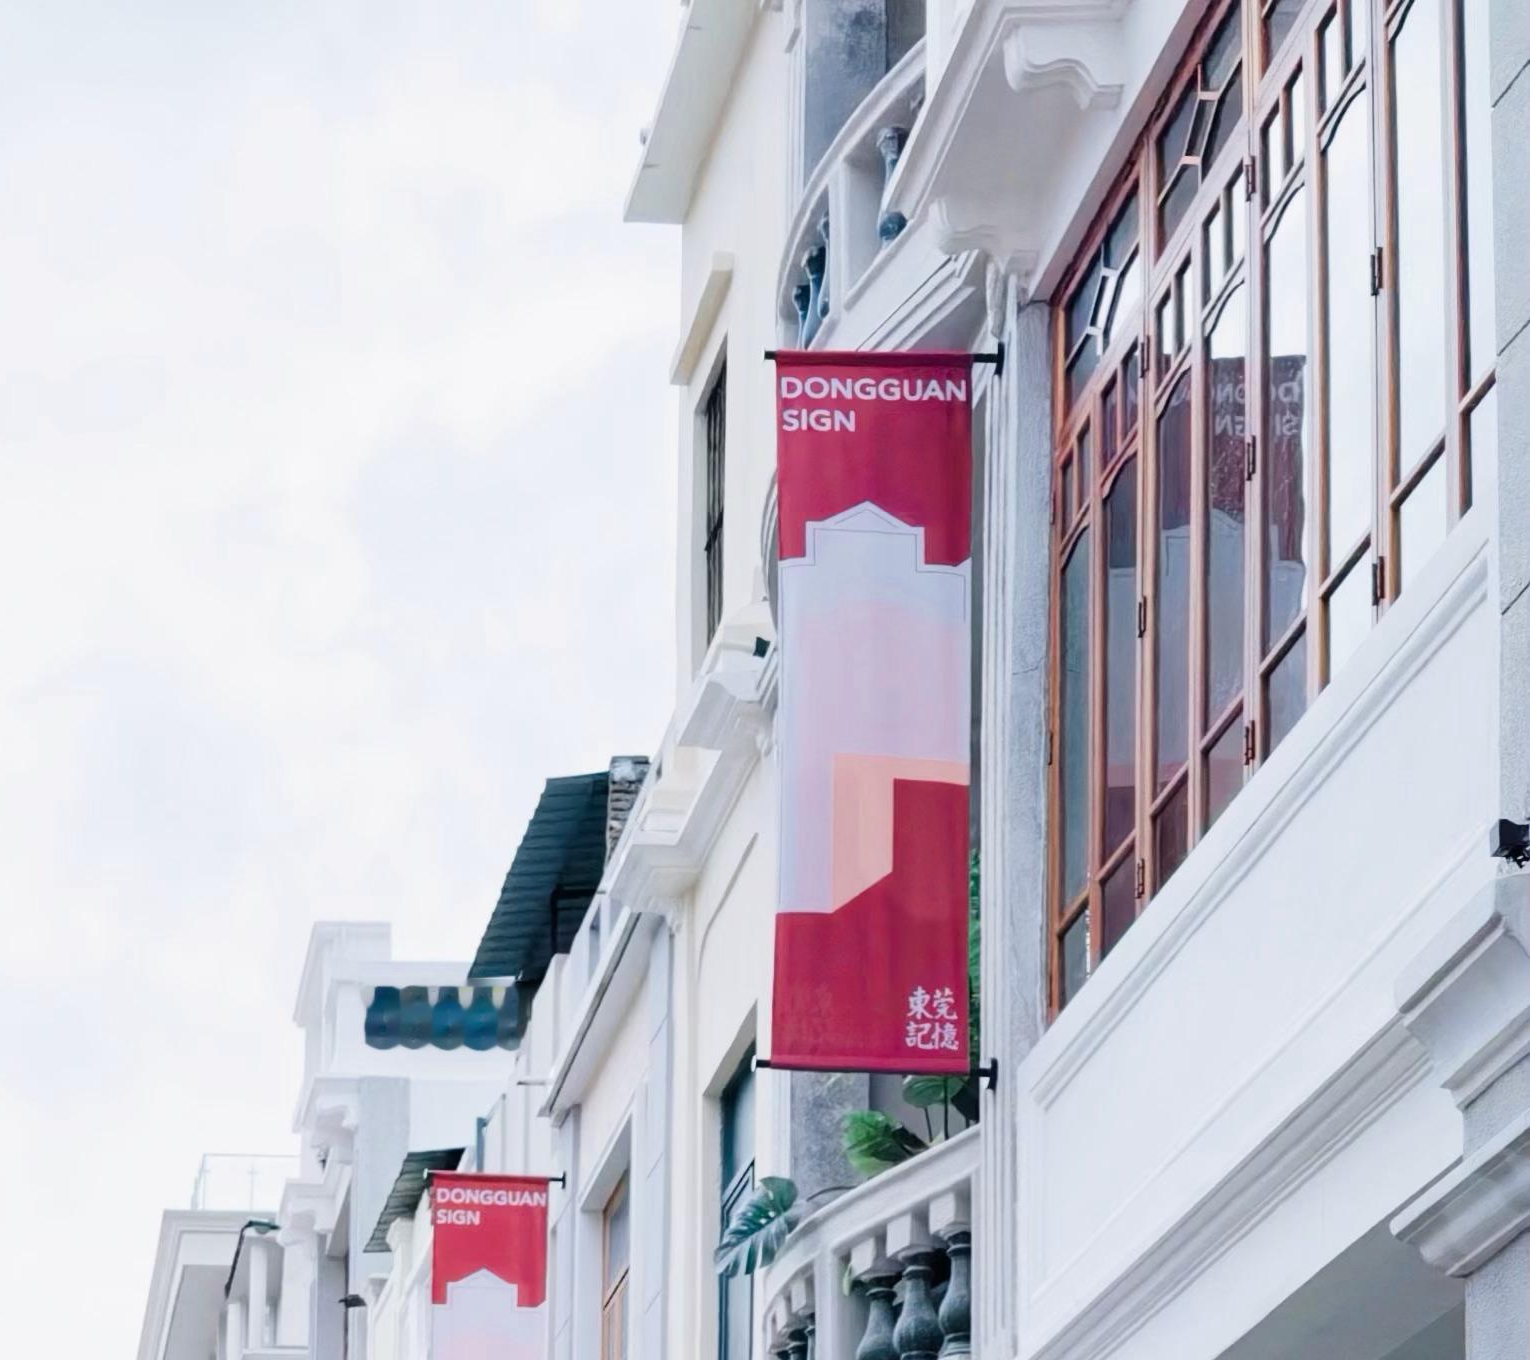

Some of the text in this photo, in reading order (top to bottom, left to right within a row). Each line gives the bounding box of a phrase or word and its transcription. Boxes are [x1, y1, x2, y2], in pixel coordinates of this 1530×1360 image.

[781, 376, 967, 402] DONGGUAN
[782, 408, 856, 432] SIGN
[907, 986, 958, 1019] 東莞
[905, 1021, 959, 1050] 記憶
[436, 1187, 547, 1207] DONGGUAN
[436, 1208, 481, 1226] SIGN
